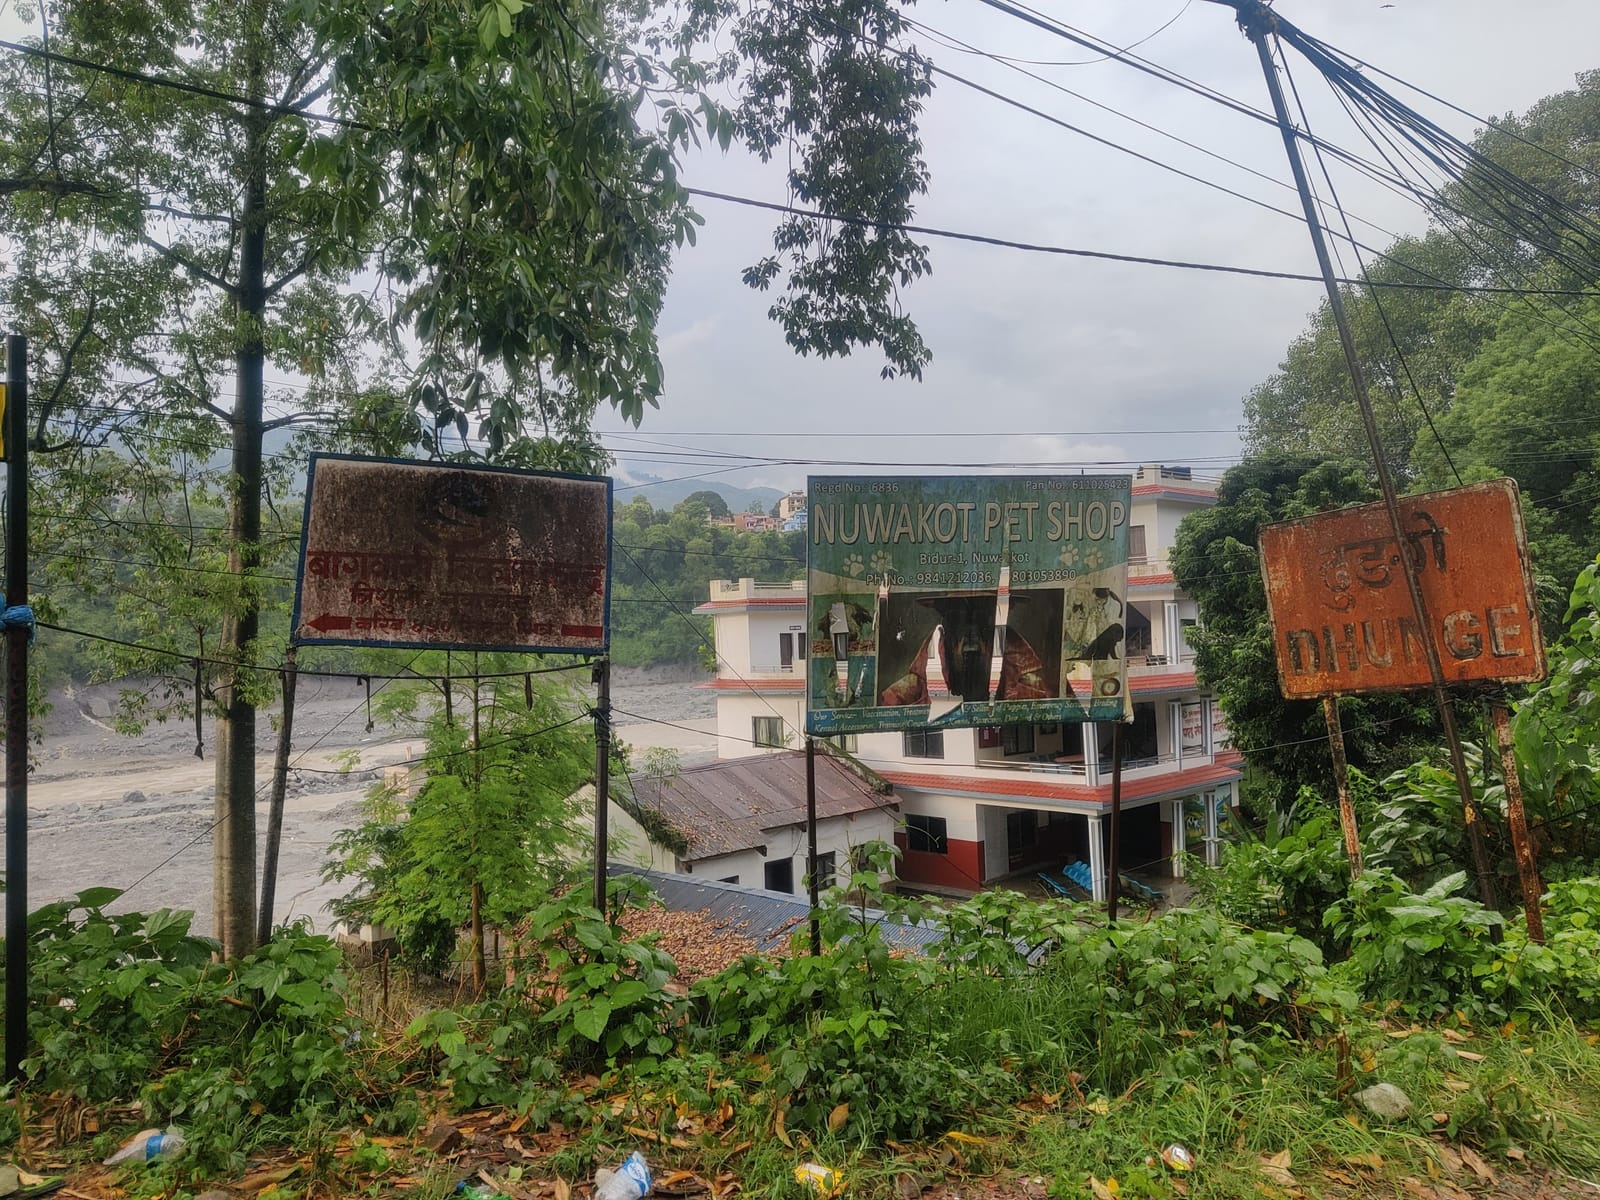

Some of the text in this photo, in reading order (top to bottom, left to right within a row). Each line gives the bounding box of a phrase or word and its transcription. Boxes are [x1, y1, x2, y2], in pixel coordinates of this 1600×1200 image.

[814, 482, 841, 494] Regd
[871, 482, 899, 492] 6836
[1025, 480, 1044, 490] Pan
[813, 501, 1126, 544] NUWAKOT PET SHOP
[920, 552, 968, 565] Bidur-1,
[1003, 569, 1076, 583] 803053890
[1286, 603, 1526, 677] DHUNGE
